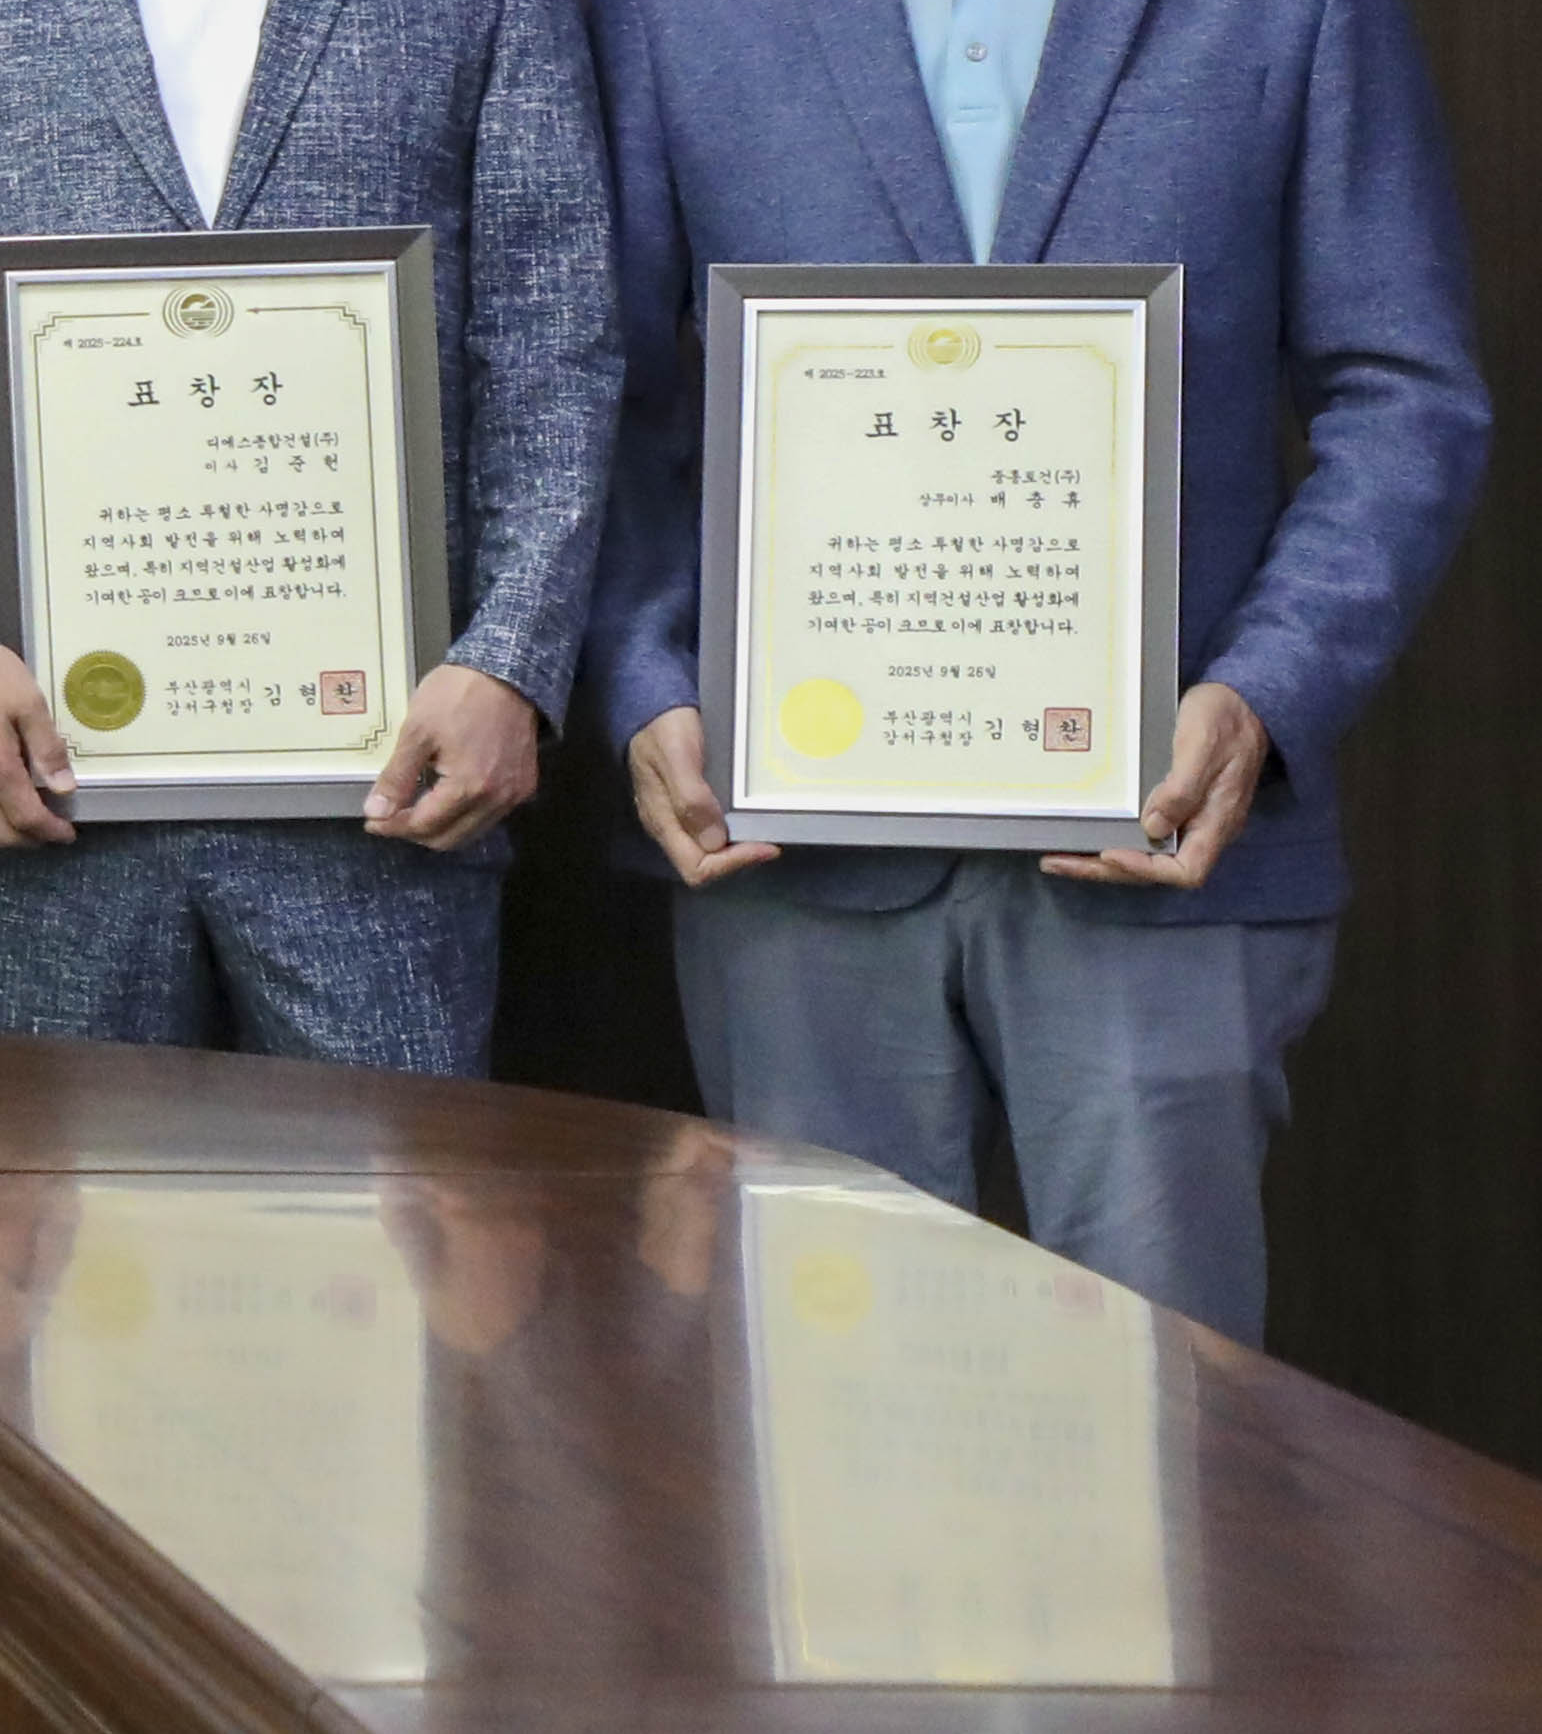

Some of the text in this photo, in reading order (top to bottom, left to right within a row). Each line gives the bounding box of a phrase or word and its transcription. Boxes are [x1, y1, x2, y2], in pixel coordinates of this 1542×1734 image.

[990, 491, 1005, 508] 배
[828, 536, 1080, 553] 귀하는 평소 투철한 사명감으로
[810, 562, 1079, 580] 지역사회 발전을 위해 노력하여
[808, 590, 1078, 608] 왔으며, 특히 지역건설산업 활성화에
[809, 617, 1077, 635] 기여한 공이 크므로 이에 표창합니다.
[888, 665, 996, 679] 2025년 9월 26일
[165, 678, 250, 695] 부산광역시
[167, 698, 252, 716] 강서구청장
[883, 710, 971, 726] 부산광역시
[884, 730, 973, 747] 강서구청장
